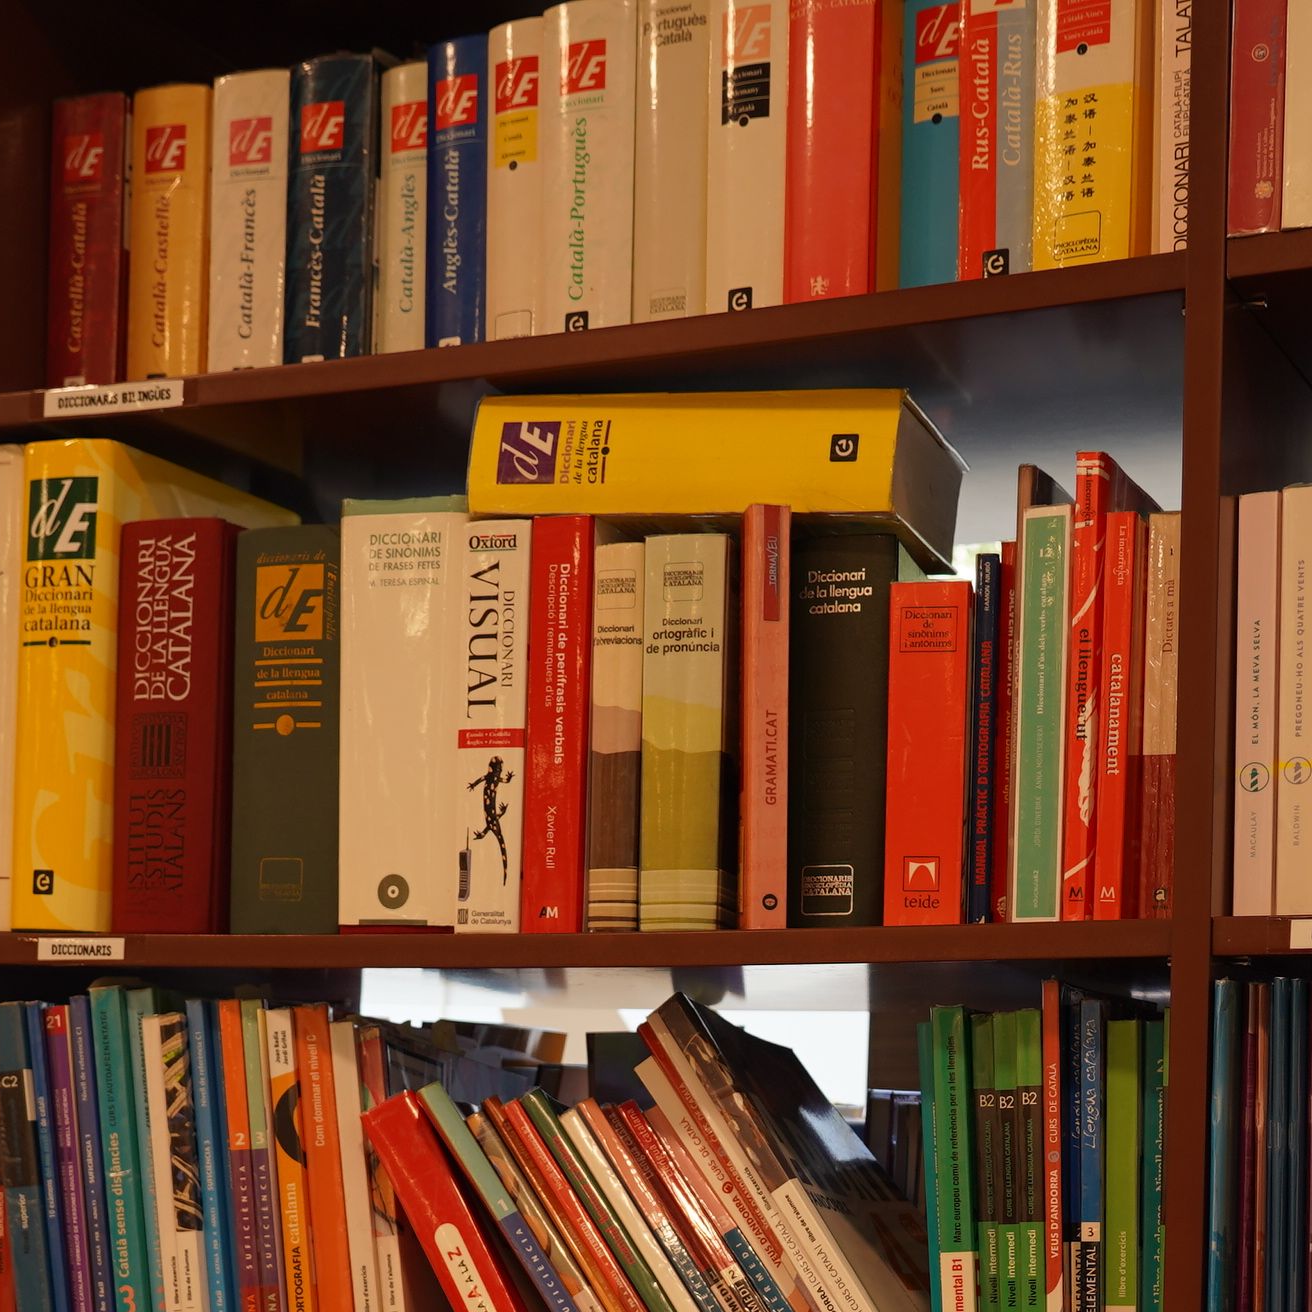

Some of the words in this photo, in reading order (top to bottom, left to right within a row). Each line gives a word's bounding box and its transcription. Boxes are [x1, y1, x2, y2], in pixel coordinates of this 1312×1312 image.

[971, 39, 990, 170] Rus-Català
[1003, 34, 1022, 166] Català-Rus
[399, 173, 415, 313] Català-Anglès
[442, 150, 460, 294] Anglès-Català
[568, 118, 588, 301] Català-Portuguès
[238, 188, 257, 339] Català-Francès
[306, 174, 326, 329] Francès-Català
[25, 565, 95, 588] GRAN
[469, 534, 517, 551] Oxford
[24, 617, 90, 631] catalana
[167, 532, 196, 700] CATALANA
[558, 563, 570, 631] Diccionari
[468, 560, 501, 718] VISUAL
[555, 654, 568, 714] perífrasis
[1107, 654, 1121, 777] catalanament
[554, 718, 565, 764] verbals
[765, 709, 779, 805] GRAMATI.CAT
[545, 805, 557, 848] Xavier
[904, 894, 940, 909] teide
[1022, 1093, 1037, 1105] B2
[288, 1182, 301, 1242] catalana
[448, 1246, 462, 1260] Z
[461, 1260, 472, 1276] LA
